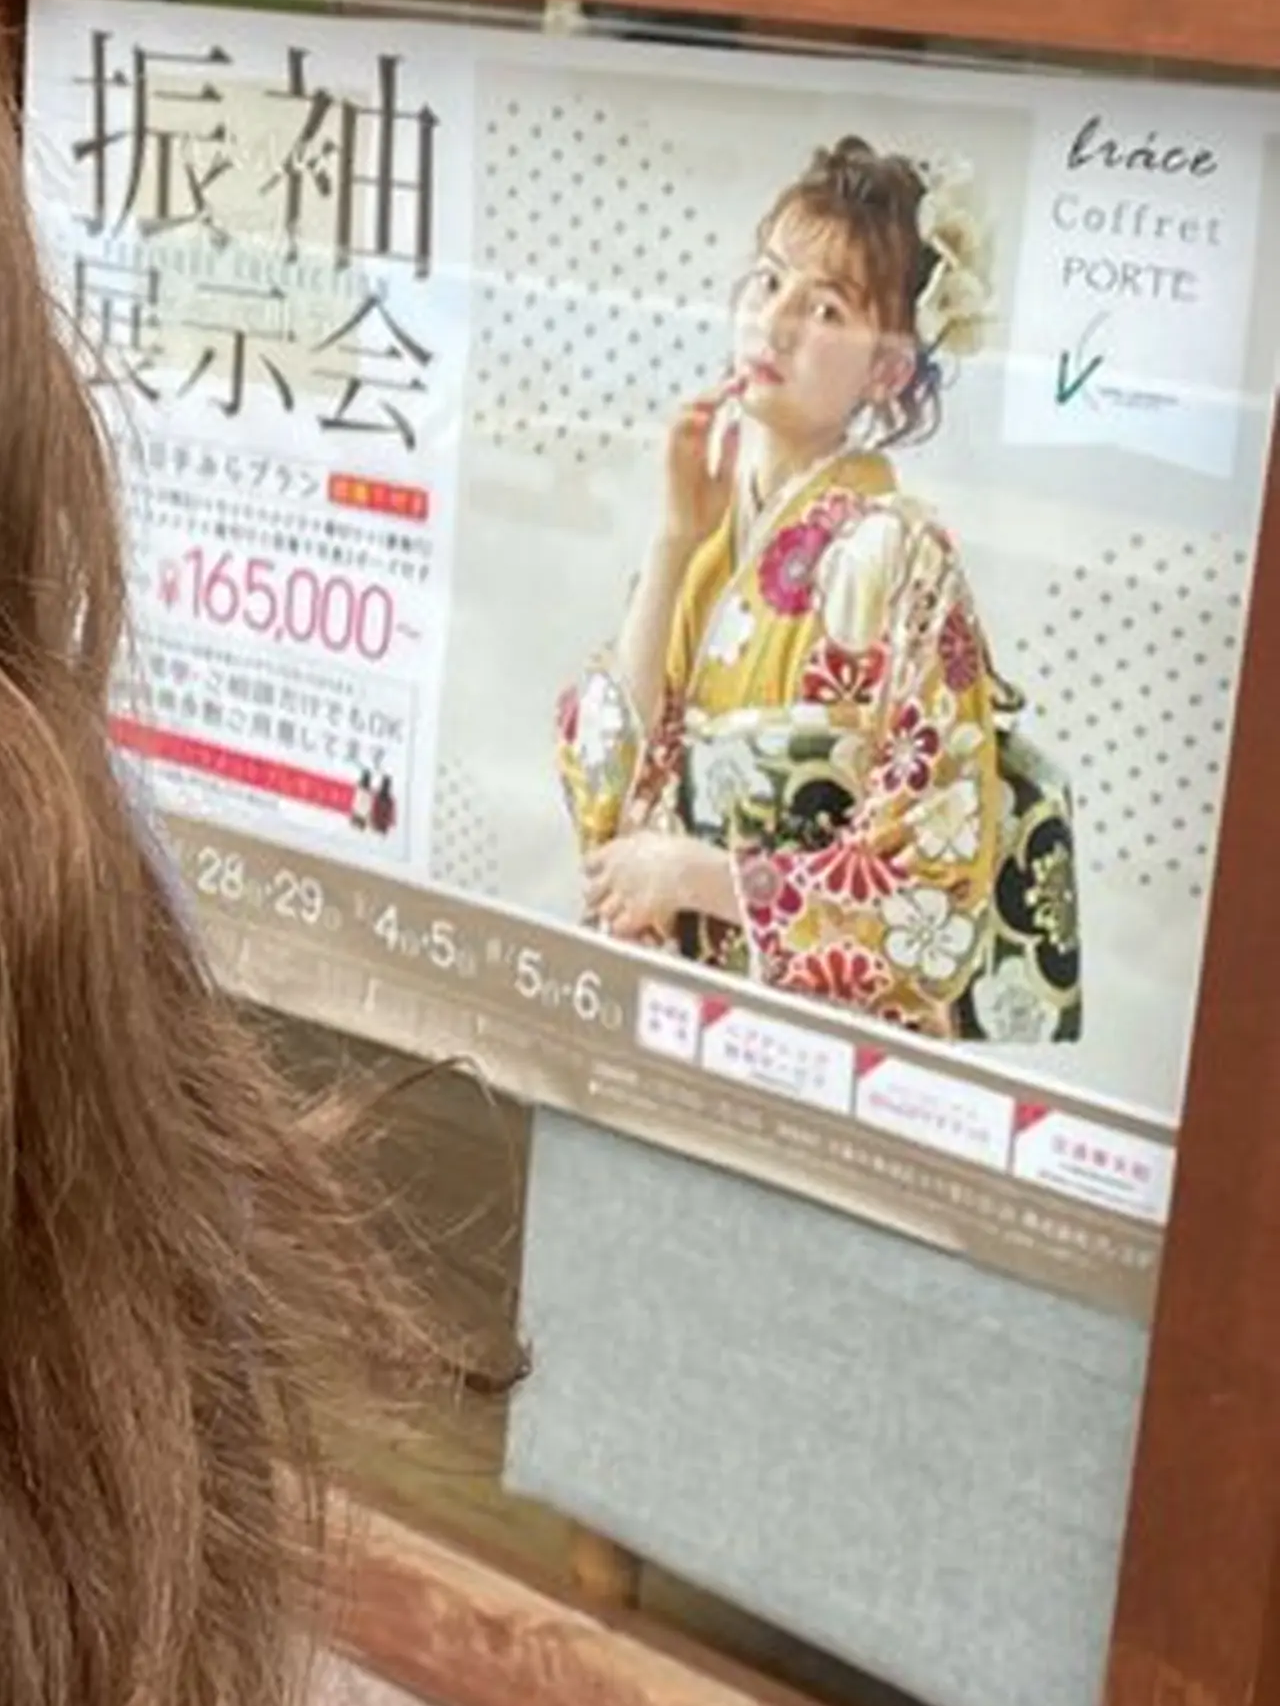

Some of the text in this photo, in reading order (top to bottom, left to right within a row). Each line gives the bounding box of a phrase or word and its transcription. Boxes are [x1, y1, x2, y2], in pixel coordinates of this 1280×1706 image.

[72, 29, 439, 280] 振袖
[1052, 192, 1222, 247] Coffret
[1062, 254, 1200, 302] PORTE
[75, 255, 435, 452] 展示会
[197, 845, 244, 900] 28
[273, 869, 324, 925] 29
